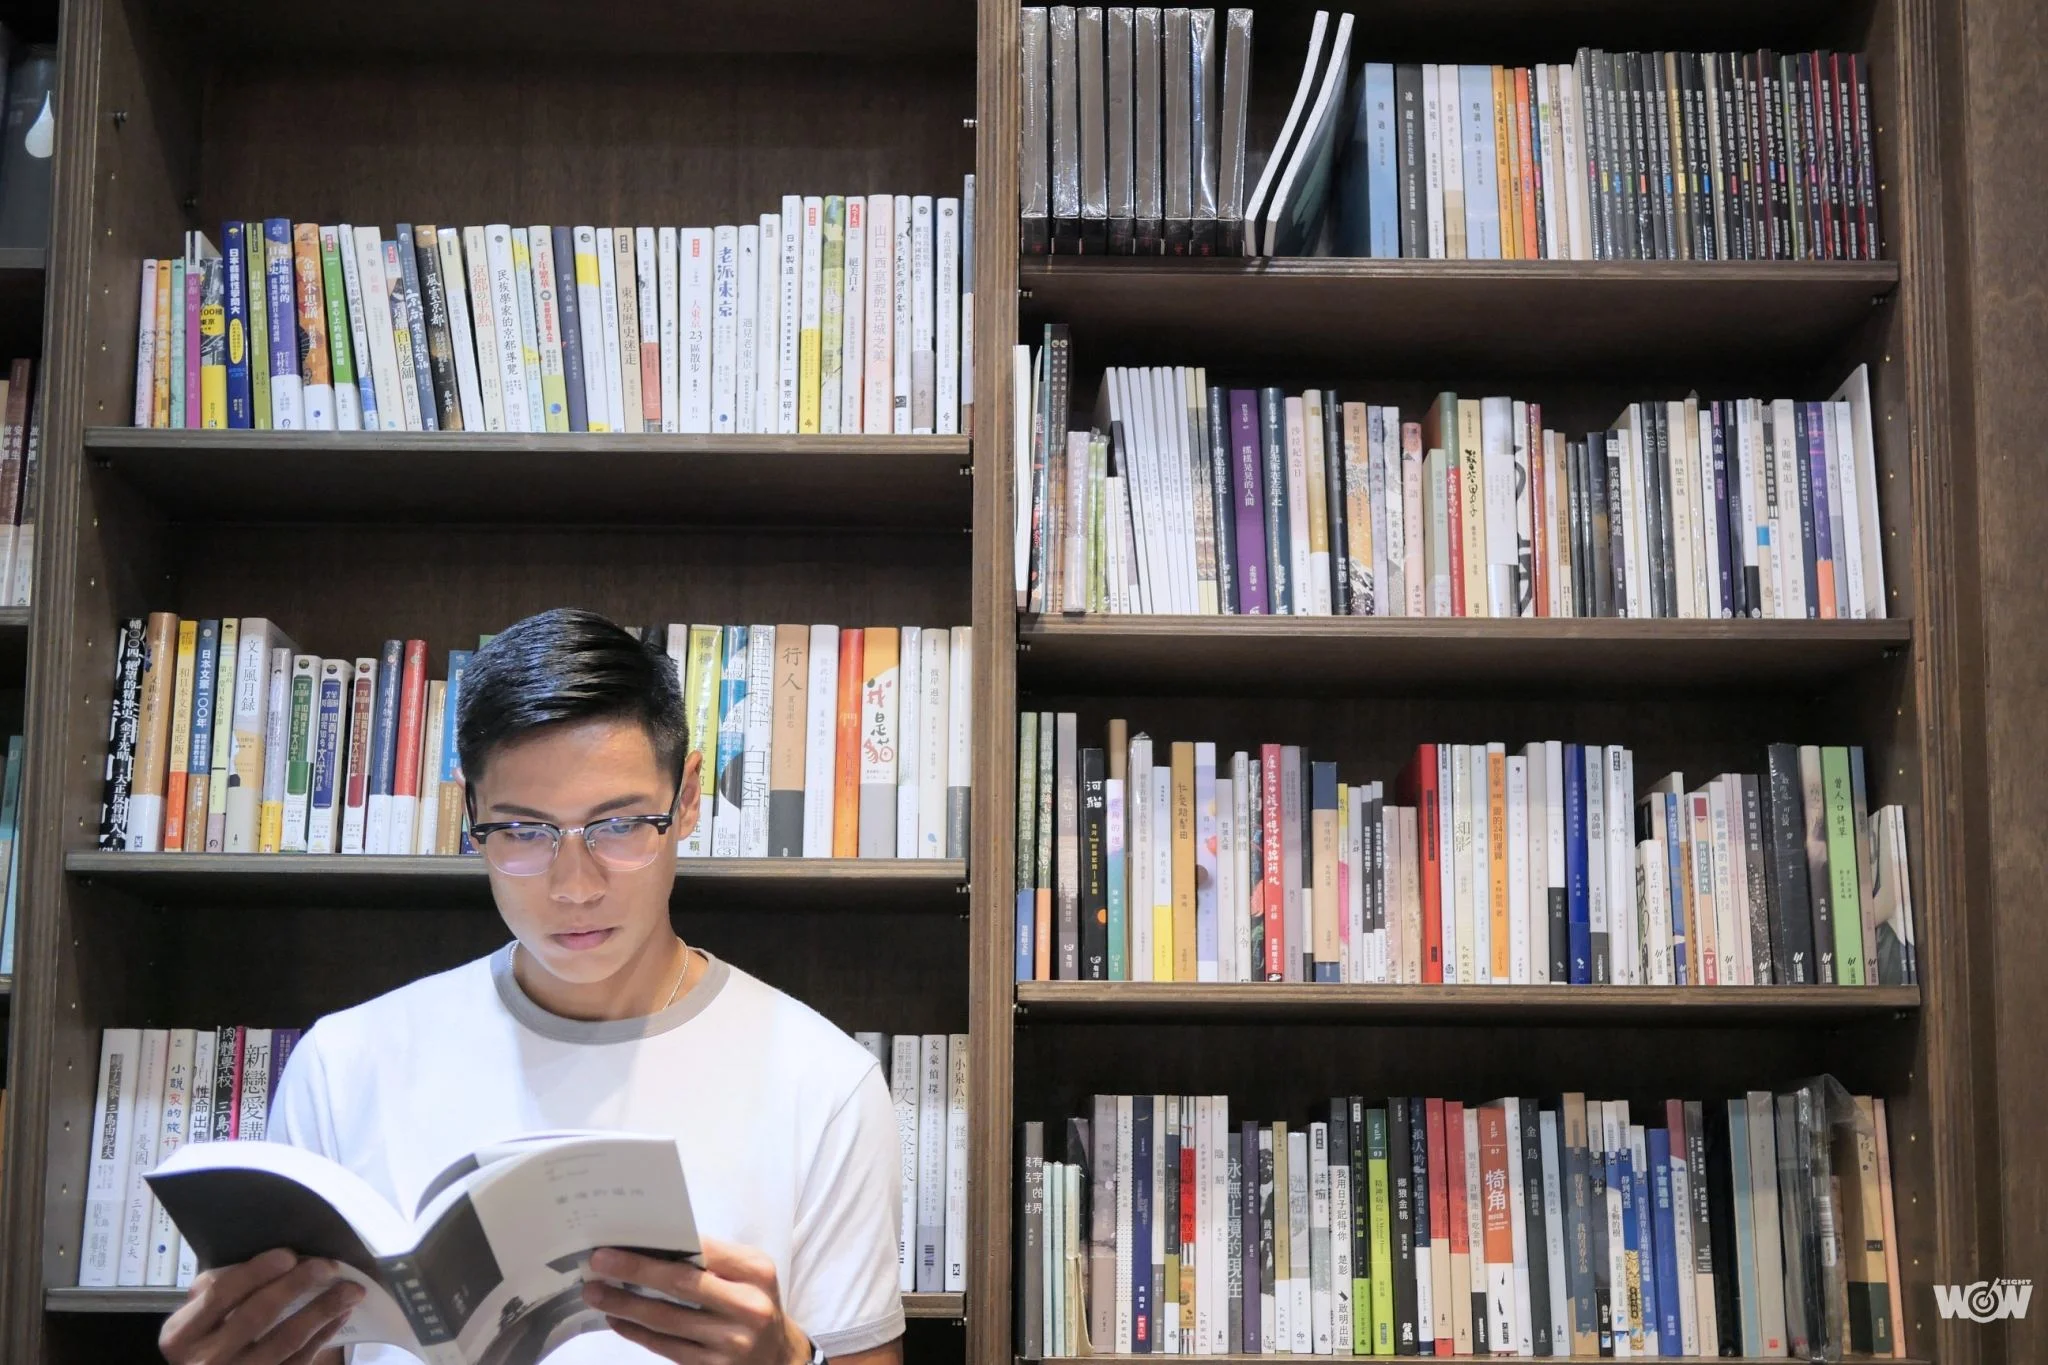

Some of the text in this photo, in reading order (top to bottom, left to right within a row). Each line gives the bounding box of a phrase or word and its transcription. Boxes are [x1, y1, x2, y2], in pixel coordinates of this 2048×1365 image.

[718, 246, 735, 318] 老派東京
[785, 234, 795, 275] 日本製造
[303, 258, 318, 319] 金澤不思議
[426, 272, 445, 327] 風雲京都
[473, 264, 492, 329] 京都の平熱
[497, 269, 518, 376] 民族學家的京都導覽
[622, 287, 637, 366] 東京歷史迷走
[783, 378, 793, 421] 東京碎片
[1243, 446, 1254, 506] 搖搖晃晃的人間
[120, 659, 140, 719] 絕望的精神史
[241, 639, 260, 713] 文士風月錄
[782, 647, 803, 692] 行人
[116, 723, 132, 762] 金子光晴
[864, 677, 894, 764] 我是貓
[1266, 754, 1280, 887] 原來女孩不想嫁給阿北
[164, 1064, 186, 1148] 小說家的旅行
[192, 1086, 209, 1143] 性命出售
[240, 1044, 269, 1142] 新戀愛講
[1033, 1188, 1044, 1199] 的
[1336, 1168, 1348, 1241] 我用日子記得你
[1485, 1168, 1506, 1211] 犄角
[1338, 1303, 1350, 1347] 啟明出版
